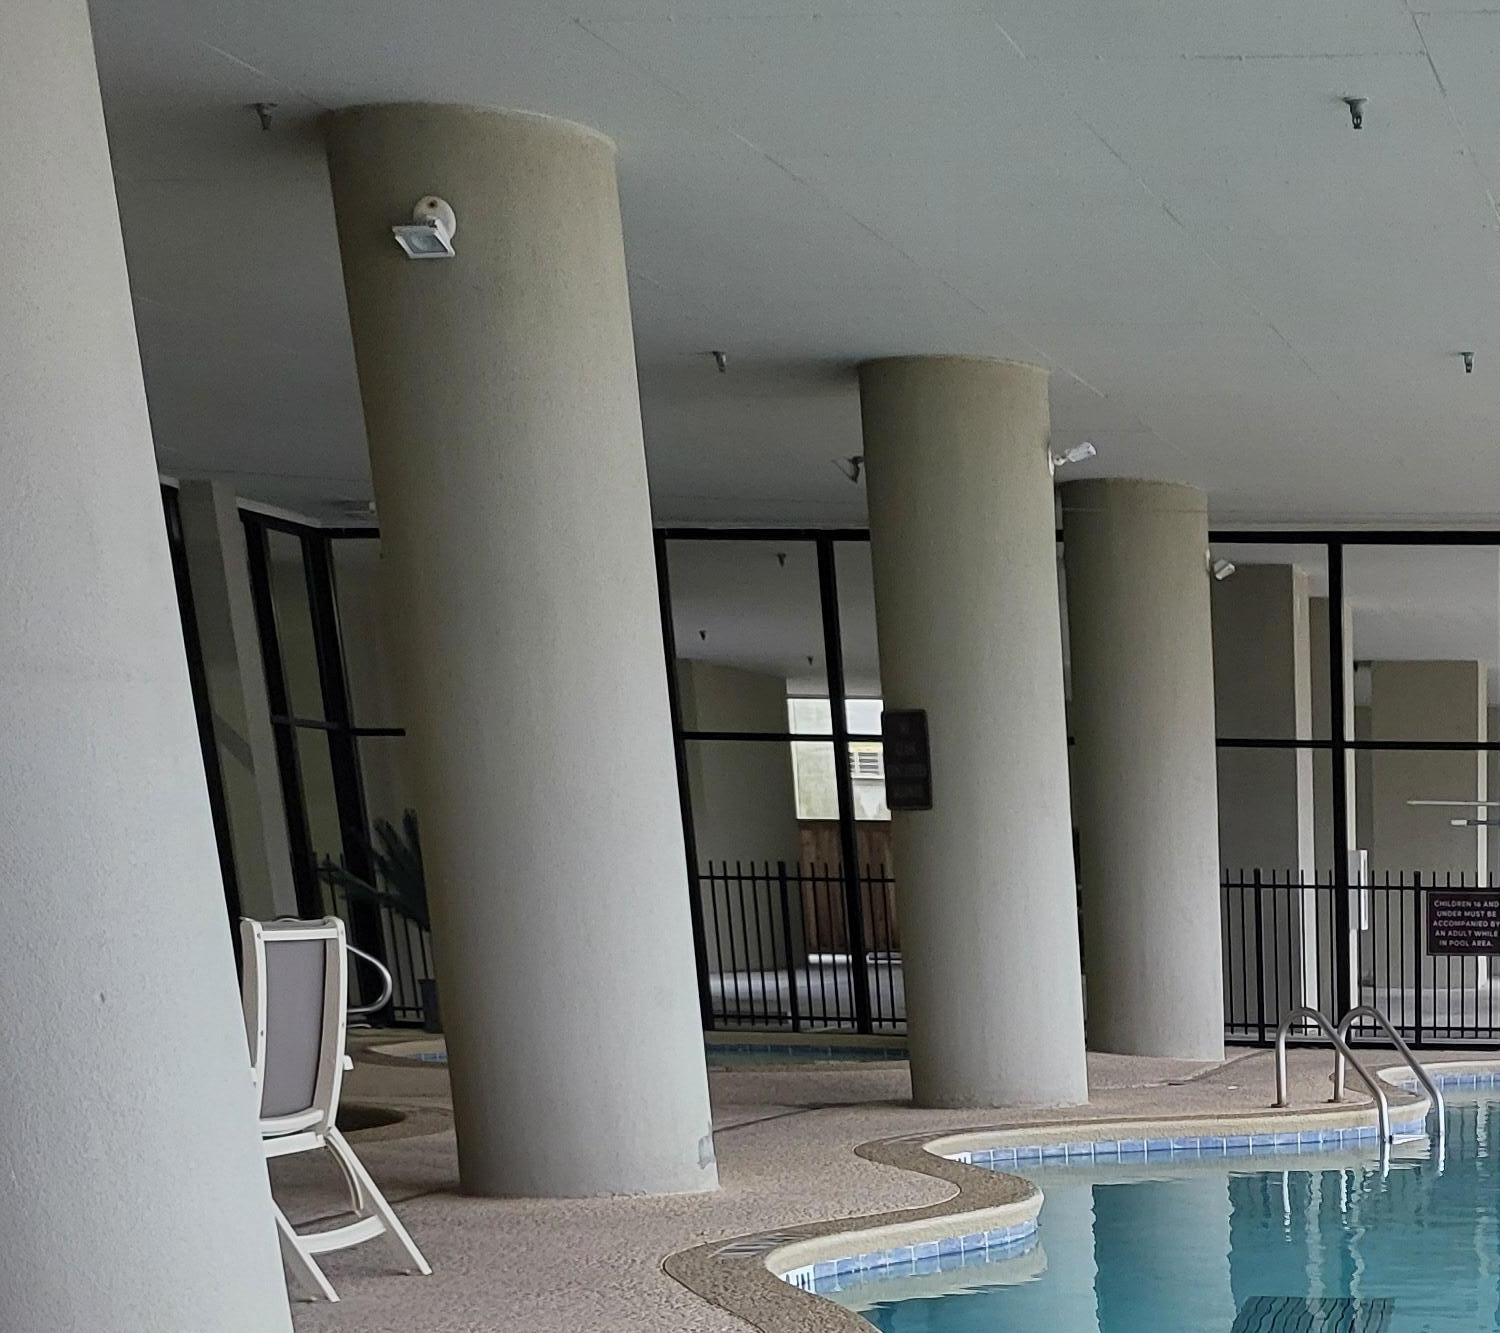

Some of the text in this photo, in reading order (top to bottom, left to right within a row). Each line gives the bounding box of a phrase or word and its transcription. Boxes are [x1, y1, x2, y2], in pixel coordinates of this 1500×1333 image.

[1434, 900, 1472, 908] CHILDREN
[1436, 910, 1497, 918] UNDER MUST BE
[1433, 920, 1500, 928] ACCOMPANIED BY
[1435, 930, 1499, 938] AN ADULT WHILE
[1439, 939, 1448, 947] IN
[1449, 939, 1469, 947] POOL
